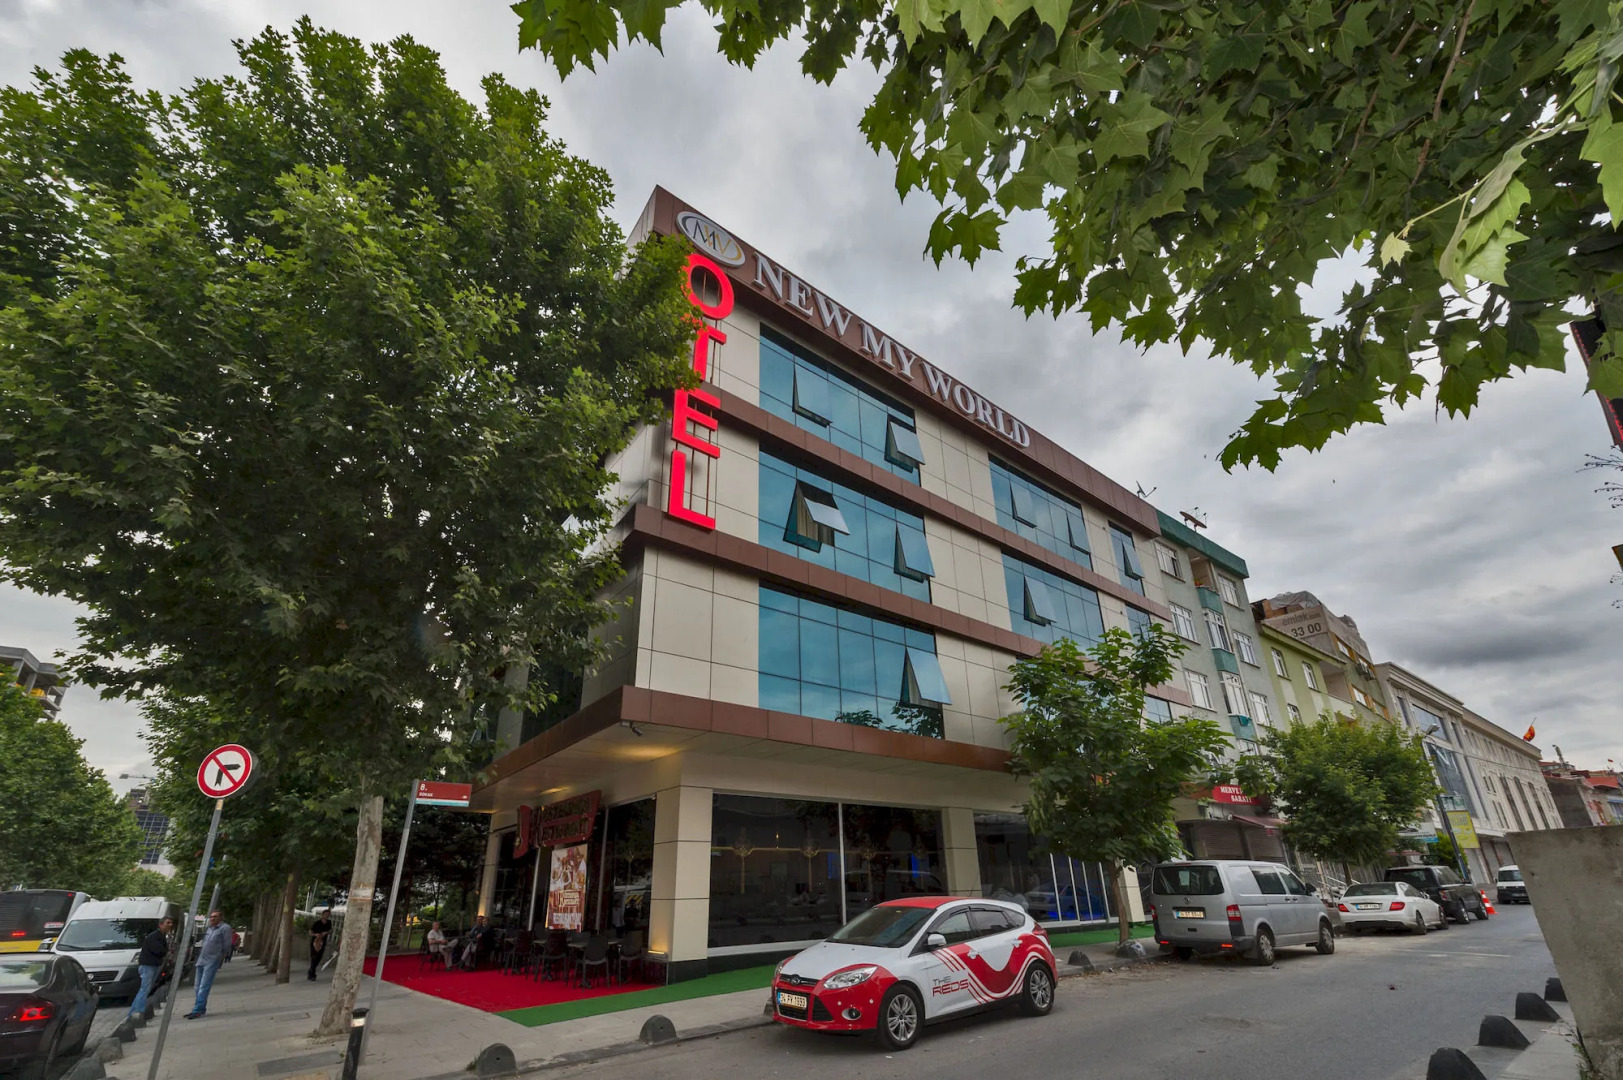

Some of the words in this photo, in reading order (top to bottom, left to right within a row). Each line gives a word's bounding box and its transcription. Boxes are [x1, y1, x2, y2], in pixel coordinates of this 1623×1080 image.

[752, 251, 852, 336] NEW
[860, 321, 917, 380] MY
[920, 361, 1030, 448] WORLD
[668, 253, 734, 530] OTEL
[1291, 626, 1305, 638] 33
[1307, 622, 1322, 634] 00
[1220, 786, 1240, 795] MERVE
[932, 975, 951, 986] THE
[932, 979, 969, 997] REDS
